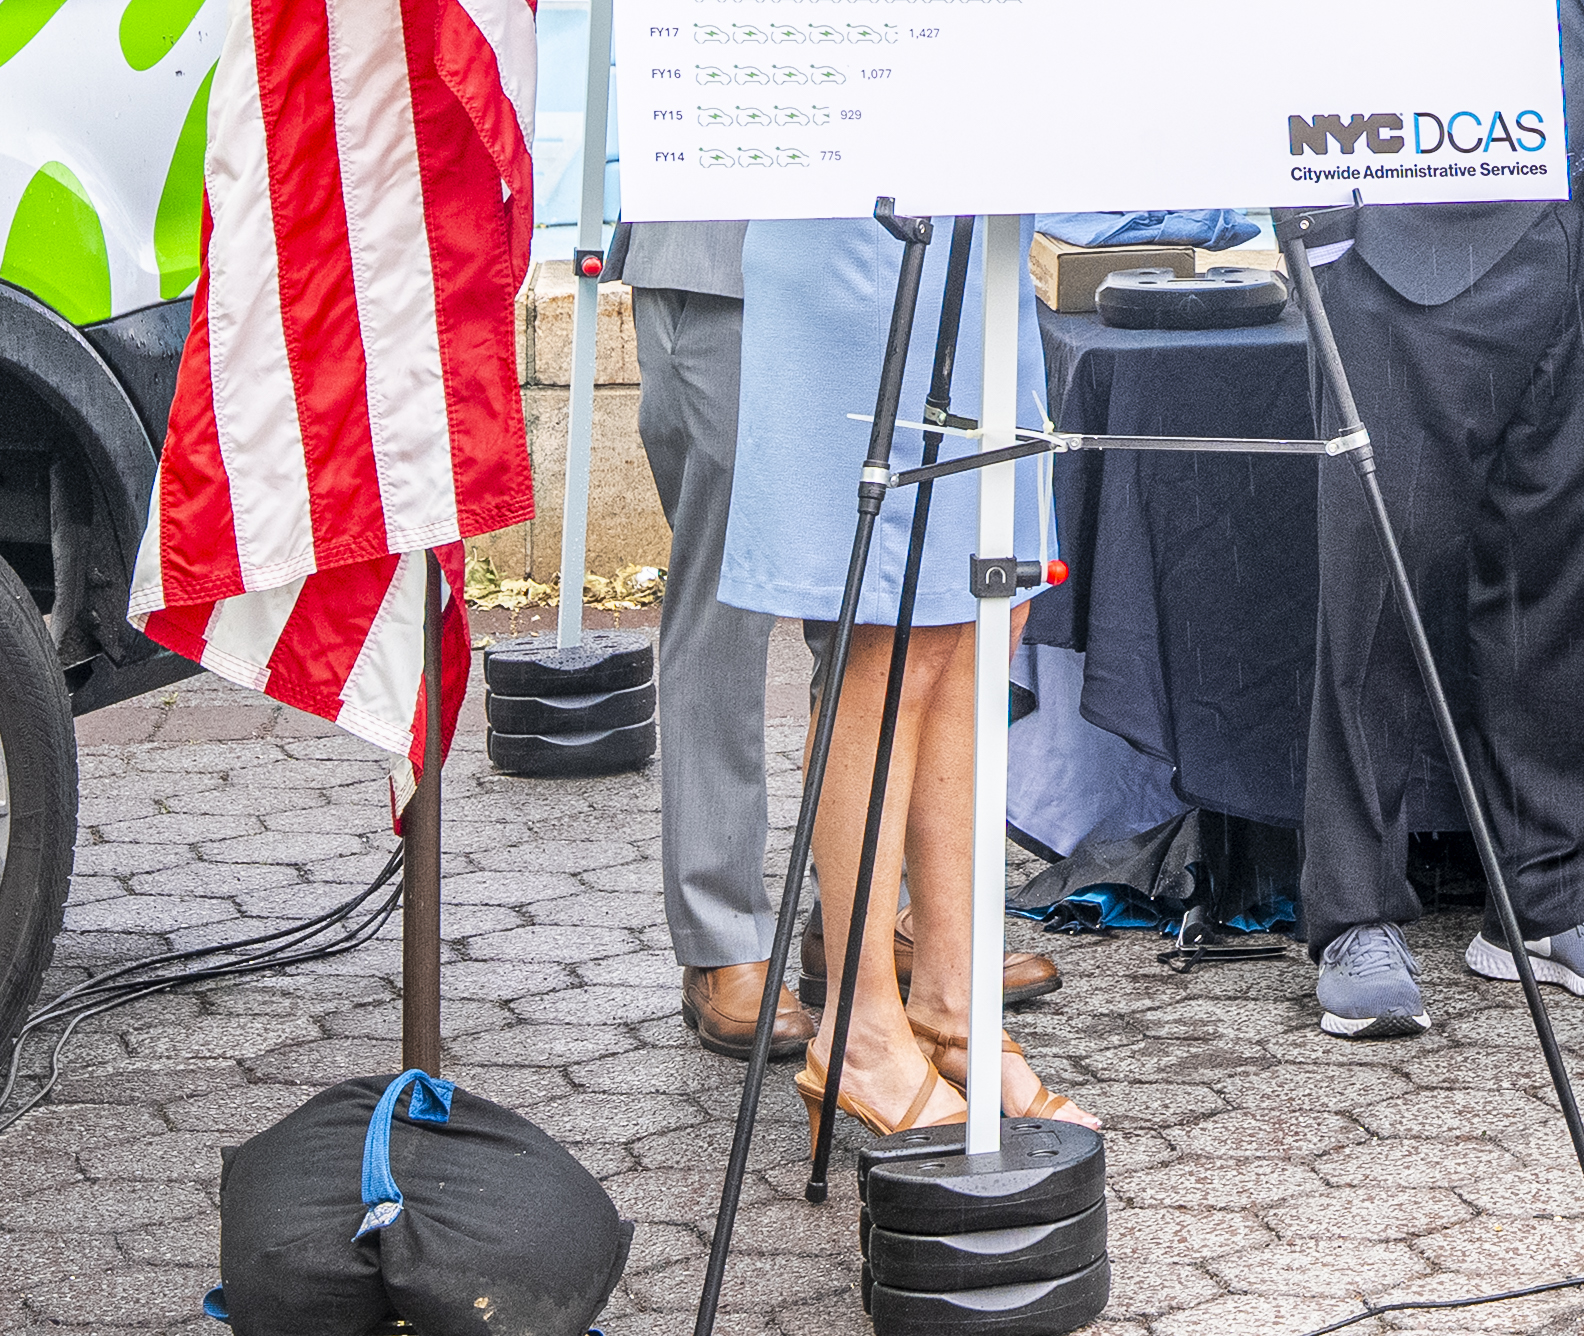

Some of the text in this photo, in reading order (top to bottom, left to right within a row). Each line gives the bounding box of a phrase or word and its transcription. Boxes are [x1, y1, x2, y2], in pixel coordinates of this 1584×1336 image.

[650, 27, 939, 39] FY17 1,427
[652, 69, 891, 79] FY16 1,077
[654, 110, 861, 120] FY15 929
[1288, 110, 1546, 155] NYC DCAS
[656, 151, 841, 161] FY14 775
[1291, 162, 1547, 184] Citywide Administrative Services
